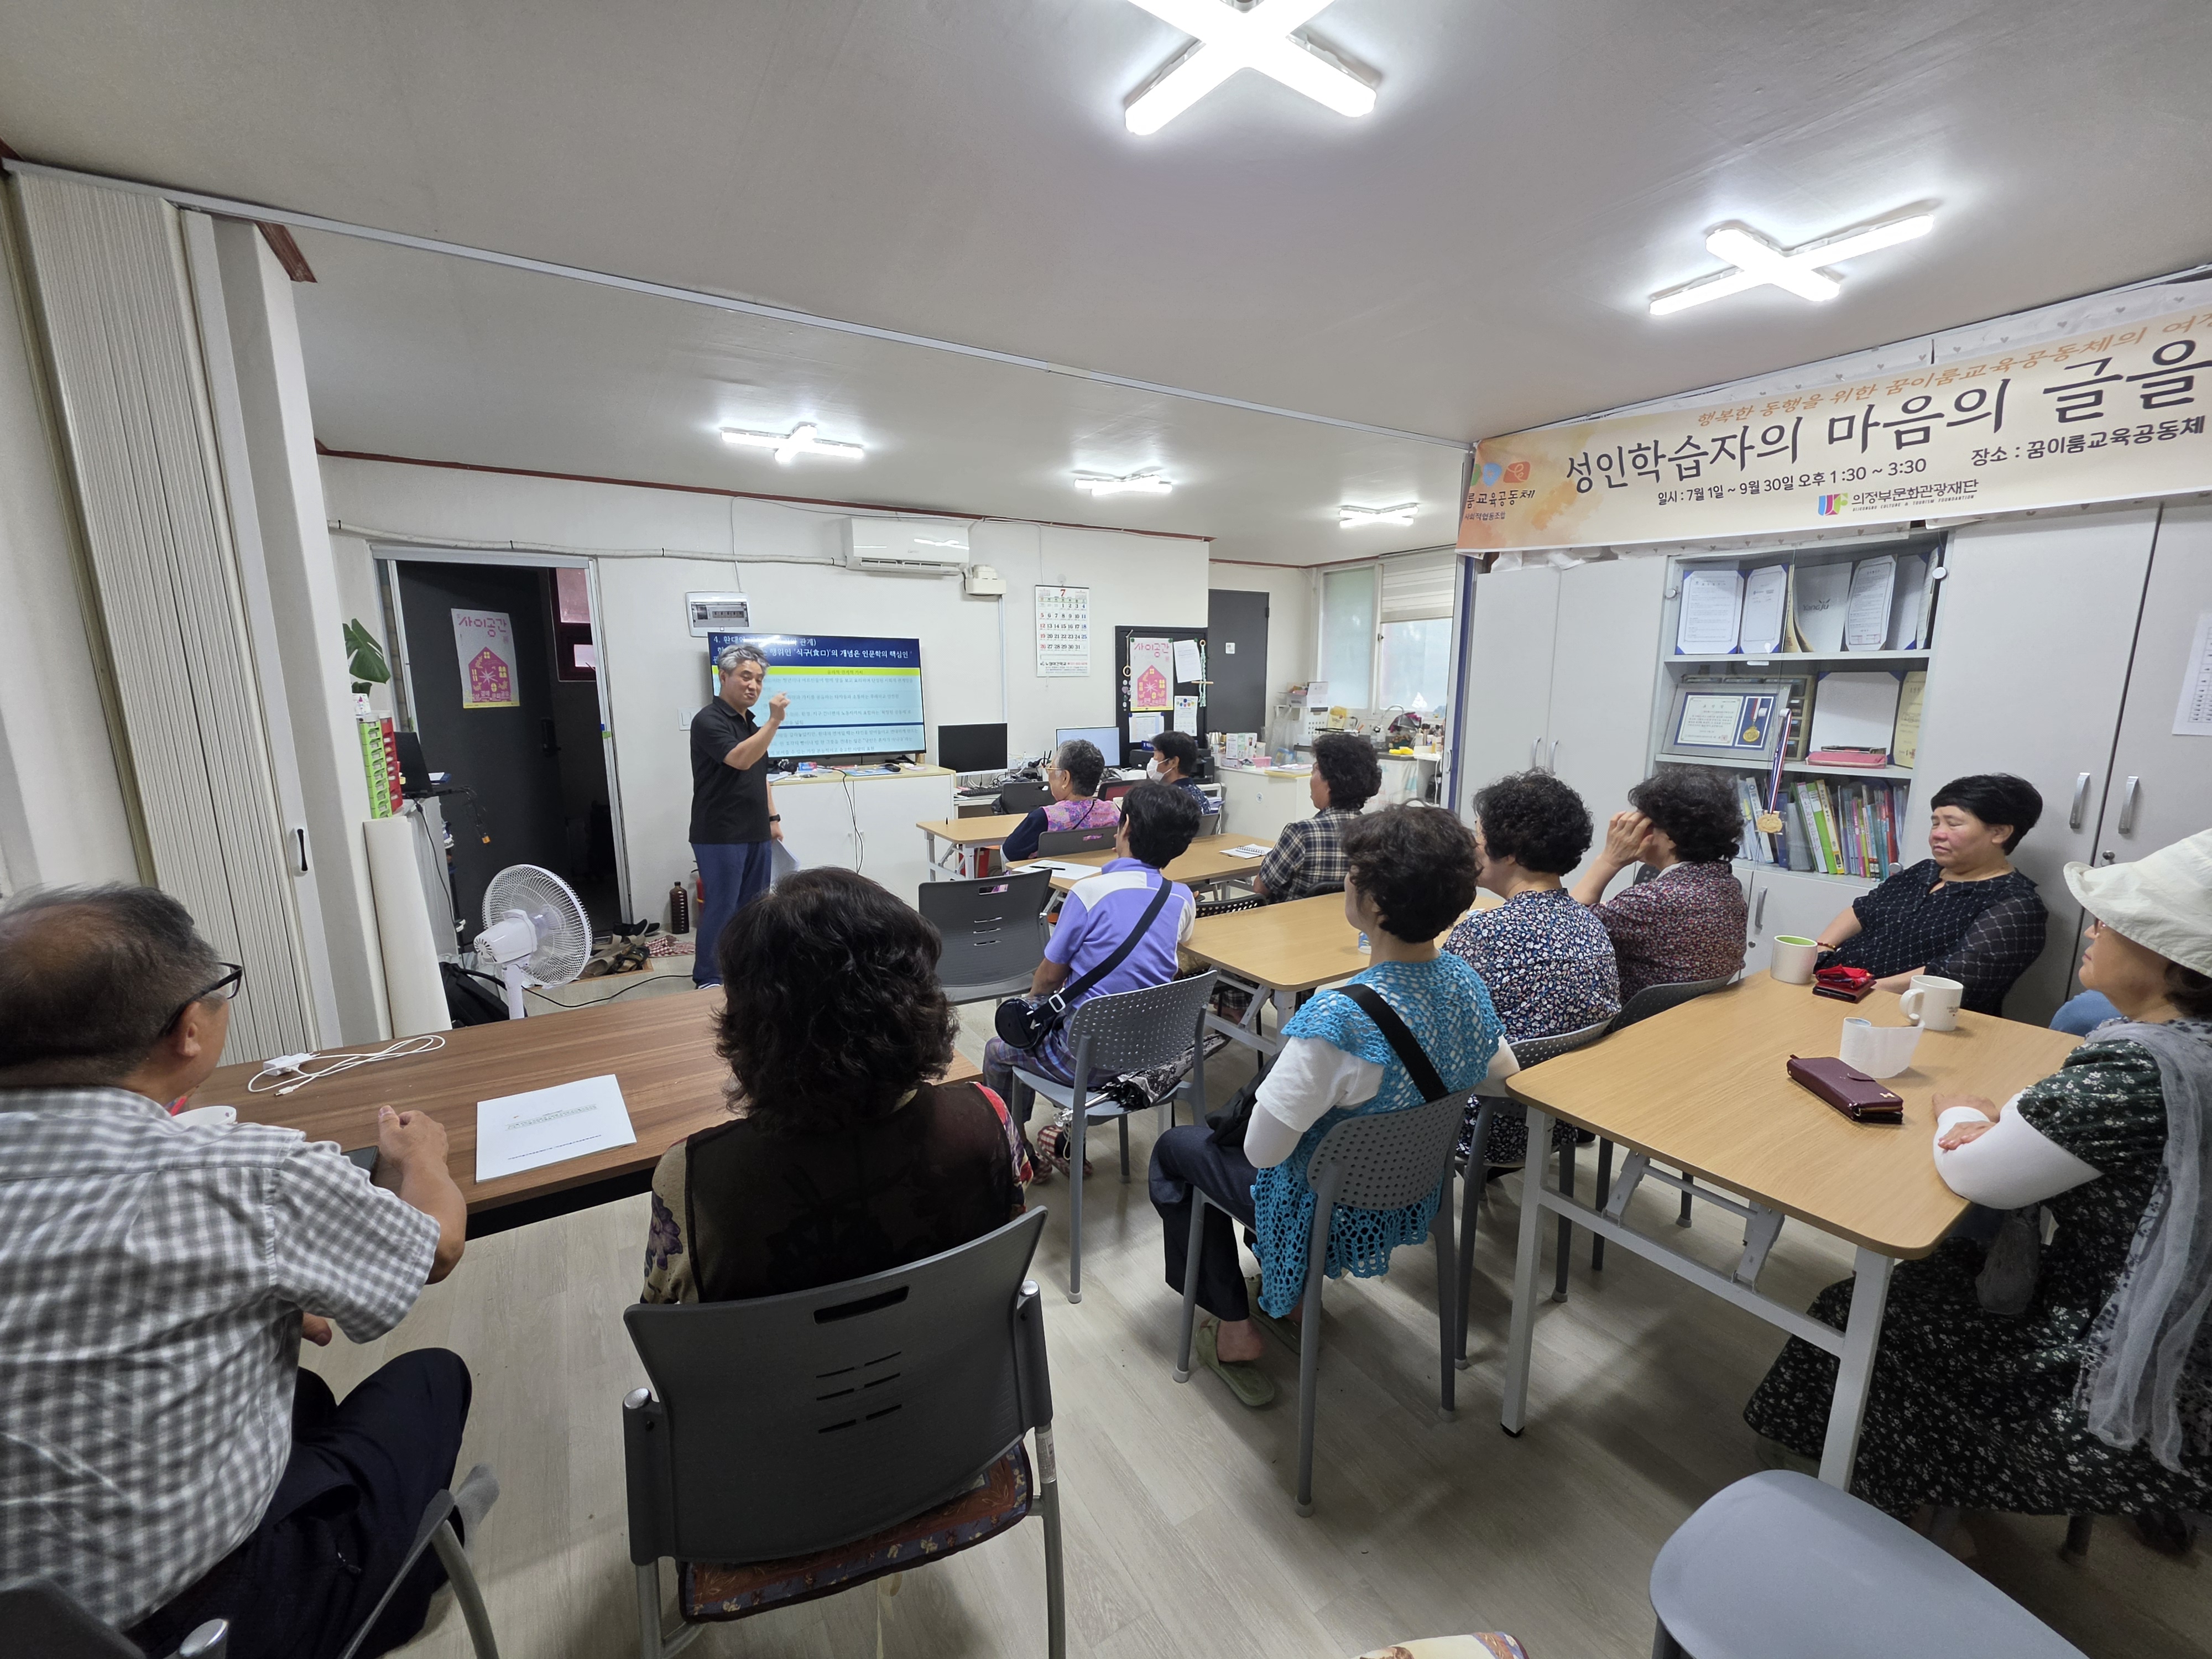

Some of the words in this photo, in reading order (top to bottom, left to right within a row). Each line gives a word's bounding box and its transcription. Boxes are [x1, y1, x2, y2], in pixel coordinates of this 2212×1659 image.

[1698, 405, 1755, 426] 행복한
[1760, 393, 1824, 418] 동행을
[1830, 384, 1878, 404] 위한
[1885, 327, 2148, 396] 꿈이룸교육공동체의
[1566, 416, 1803, 493] 성인학습자의
[1828, 378, 2011, 453] 마음의
[2043, 340, 2212, 423] 글을
[1971, 446, 2007, 467] 장소
[2026, 415, 2205, 458] 꿈이룸교육공동체
[1658, 490, 1677, 505] 일시
[1687, 487, 1704, 502] 7월
[1708, 484, 1724, 499] 1일
[1740, 479, 1760, 495] 9월
[1764, 475, 1794, 491] 30일
[1798, 472, 1825, 487] 오후
[1888, 458, 1927, 476] 3:30
[1851, 479, 1979, 505] 의정부문화관광재단
[458, 615, 508, 638] 사이공간
[840, 649, 860, 658] 개념은
[862, 650, 888, 659] 인문학의
[890, 650, 909, 659] 핵심인
[1134, 643, 1169, 658] 사이공간
